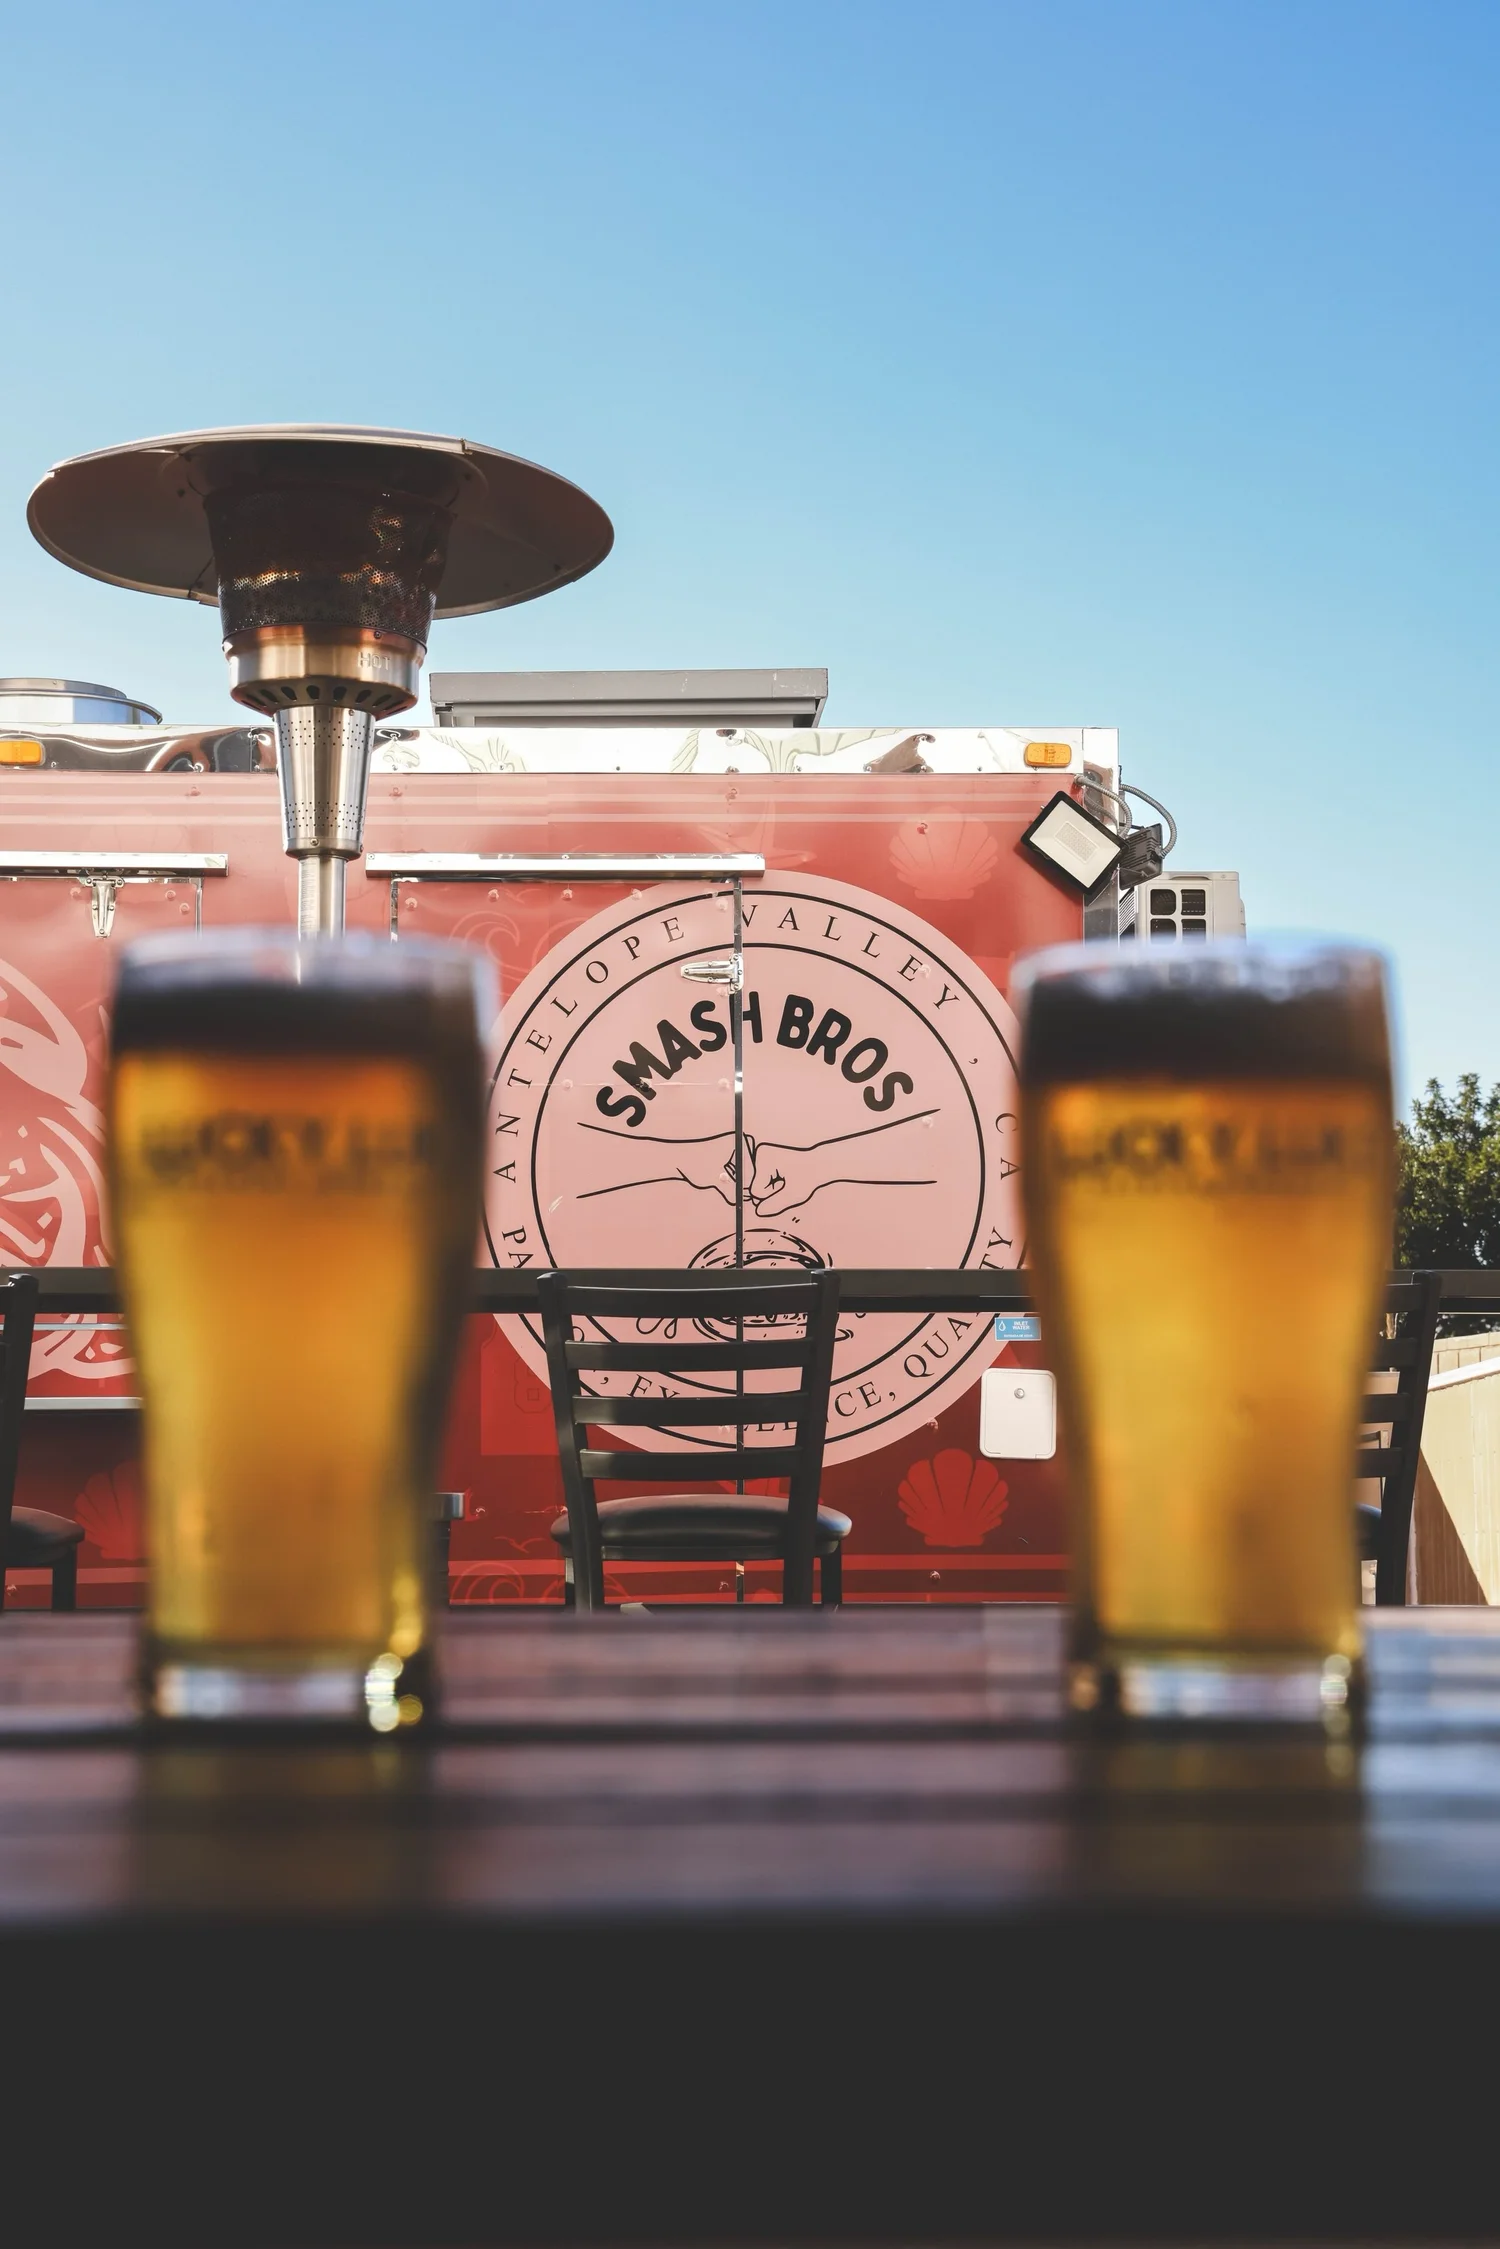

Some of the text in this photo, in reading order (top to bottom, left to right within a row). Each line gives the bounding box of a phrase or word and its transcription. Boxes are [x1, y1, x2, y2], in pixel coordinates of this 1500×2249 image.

[358, 651, 390, 670] HOT
[493, 916, 684, 1183] ANTELOPE
[596, 991, 914, 1128] SMASH BROS
